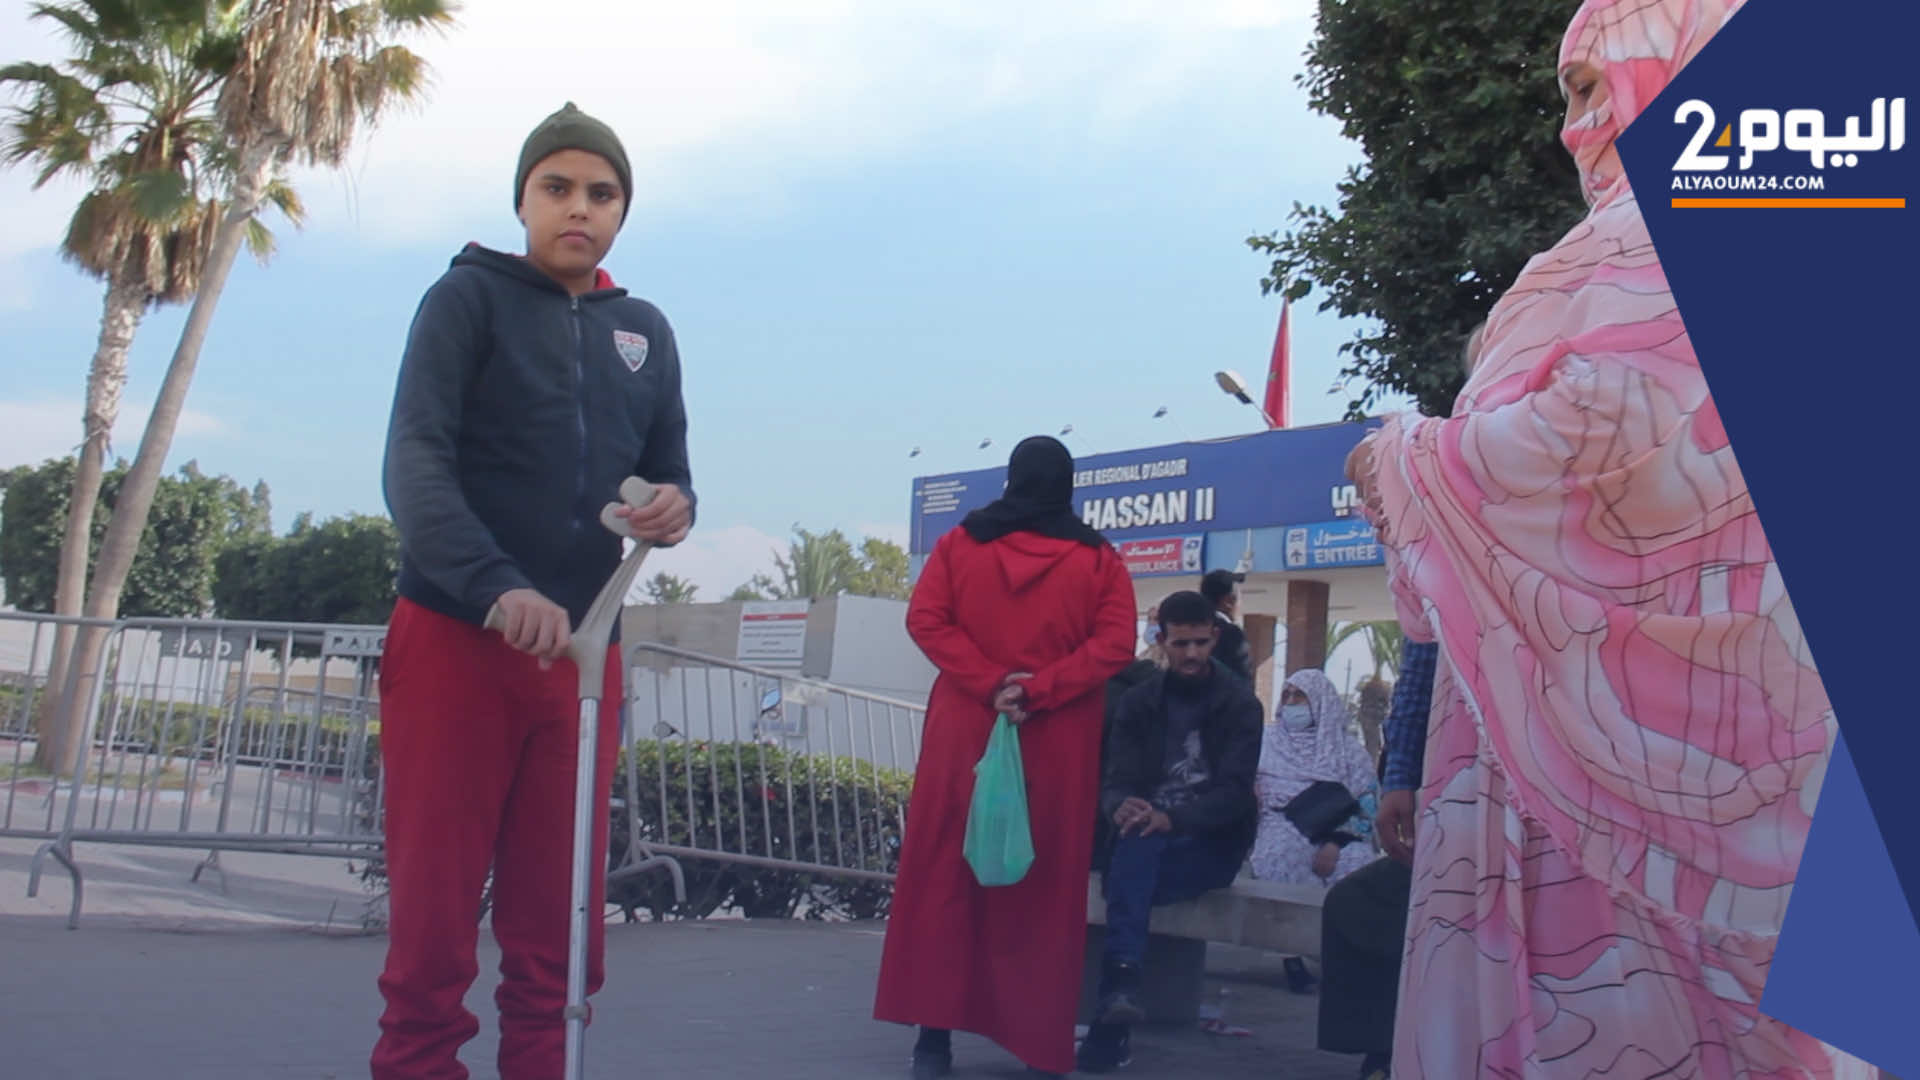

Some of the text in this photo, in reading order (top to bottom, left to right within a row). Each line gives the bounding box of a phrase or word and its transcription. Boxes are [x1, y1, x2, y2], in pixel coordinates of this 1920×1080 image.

[1073, 470, 1093, 488] LIER
[1082, 487, 1214, 531] HASSAN II
